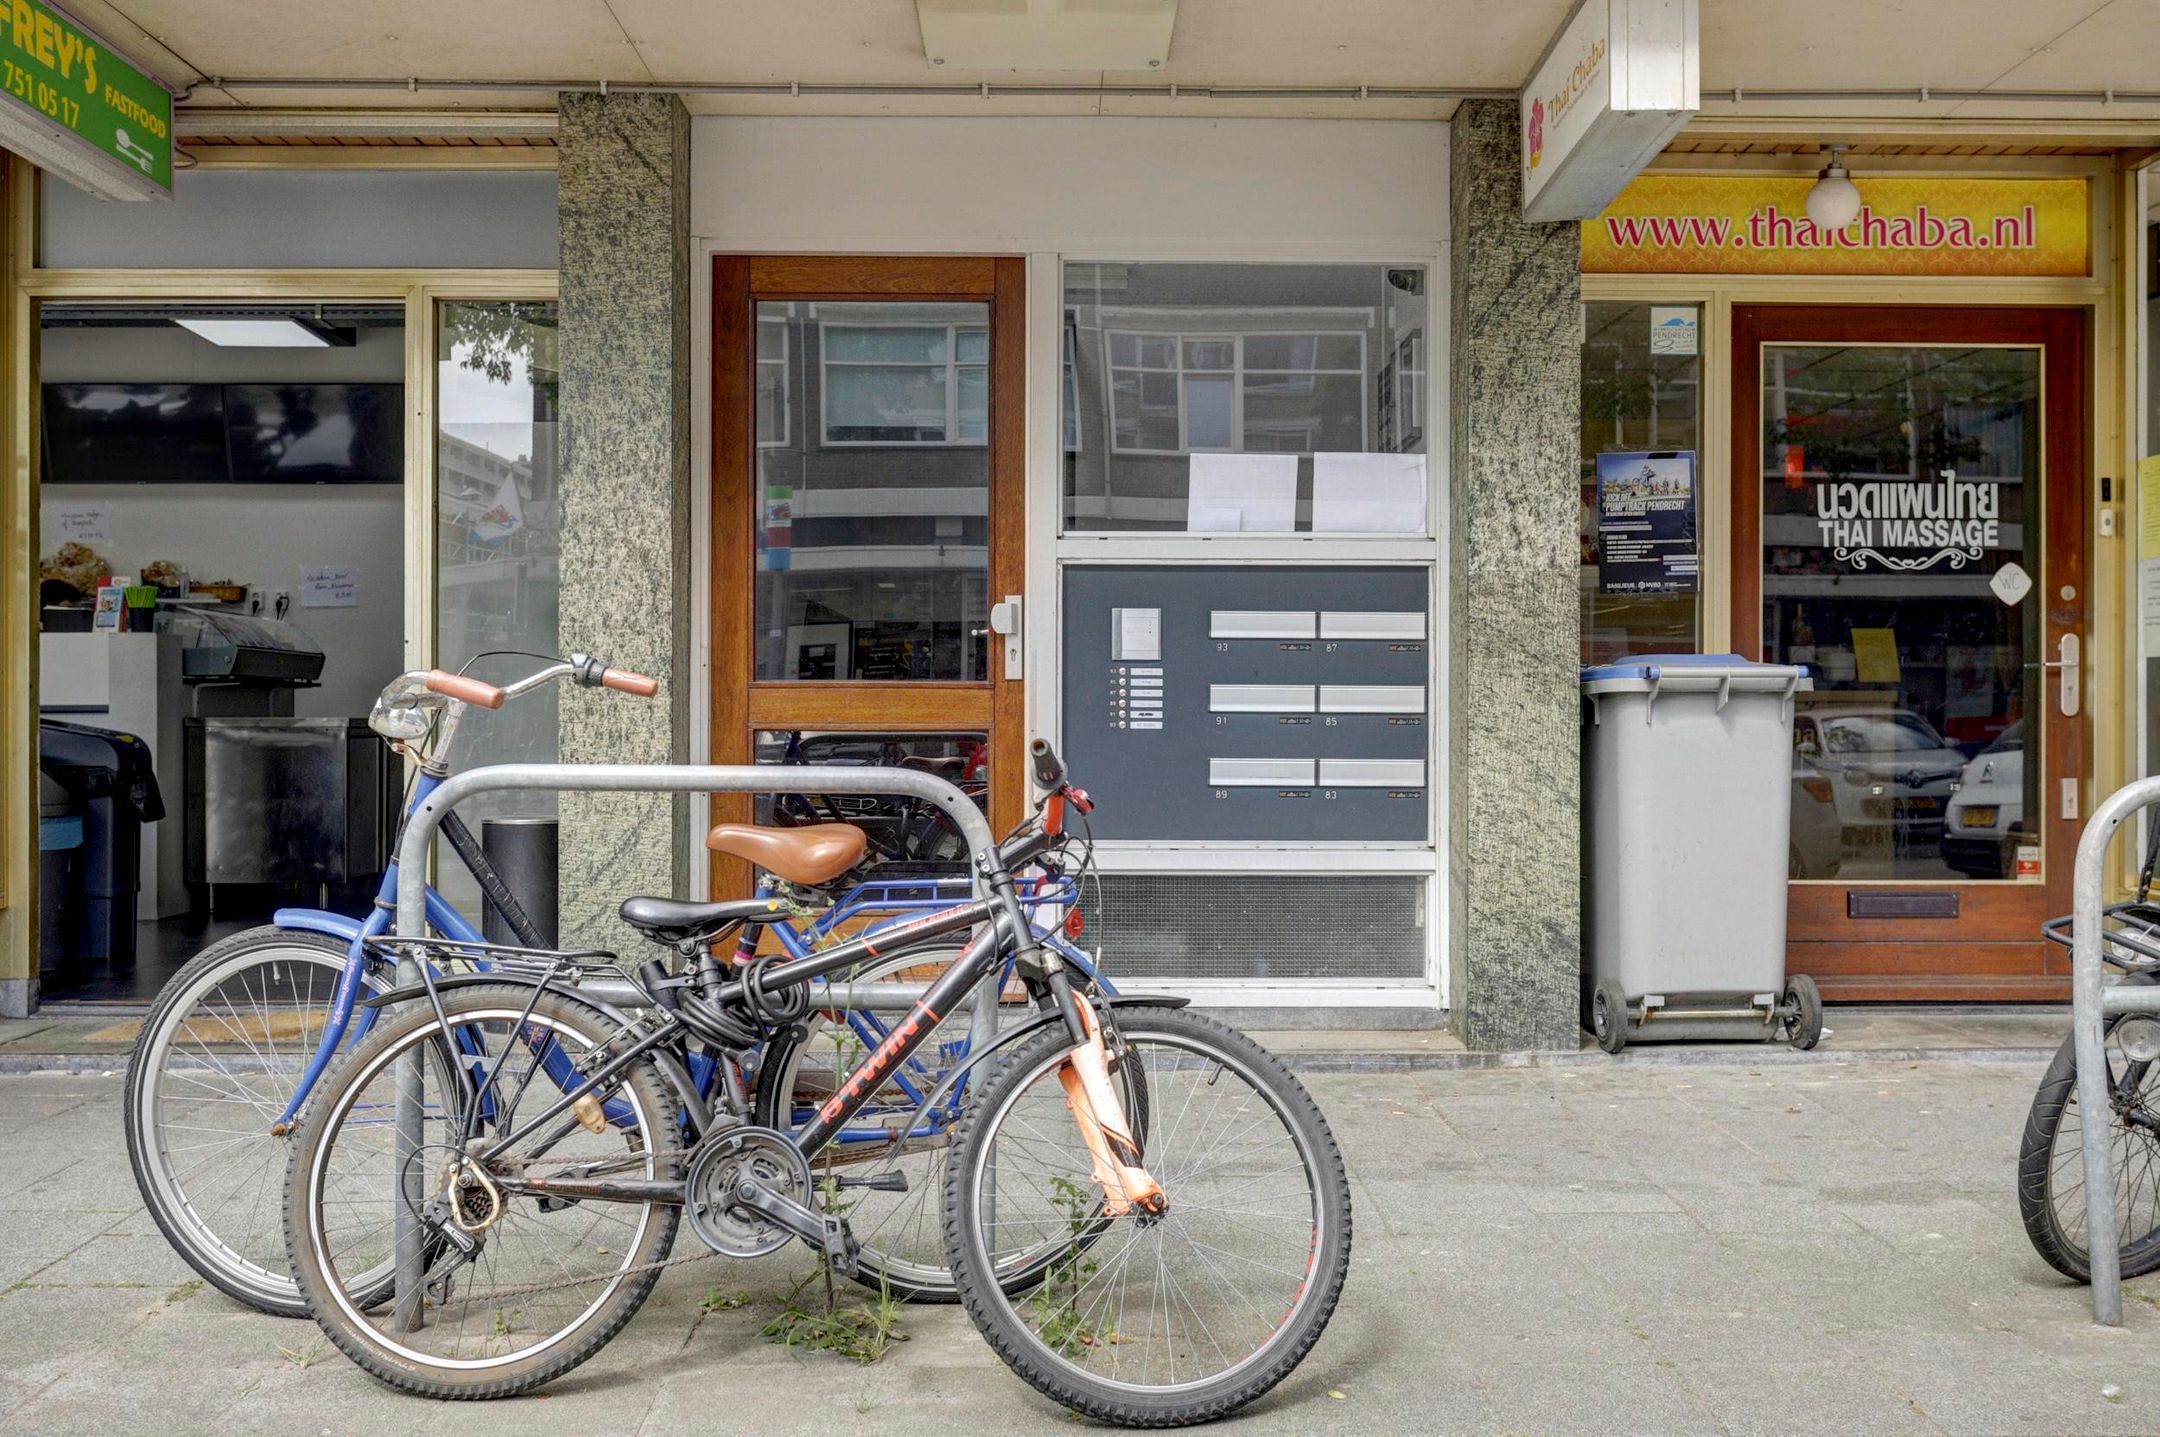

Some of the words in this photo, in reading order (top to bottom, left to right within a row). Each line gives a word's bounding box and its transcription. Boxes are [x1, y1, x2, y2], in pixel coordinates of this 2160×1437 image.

[1547, 75, 1571, 122] Thai
[1572, 38, 1605, 92] Chaba
[4, 60, 33, 103] 751
[38, 82, 58, 117] 05
[62, 96, 81, 128] 17
[104, 84, 166, 139] FASTFOOD
[1606, 501, 1646, 512] PUMPTRACK
[1647, 500, 1685, 511] PENDRECHT
[1818, 520, 1873, 547] THAI
[1882, 519, 1999, 547] MASSAGE
[1997, 572, 2021, 590] WC
[1216, 642, 1228, 652] 93
[1326, 643, 1338, 653] 87
[1215, 717, 1228, 726] 91
[1325, 717, 1337, 726] 85
[1215, 790, 1228, 799] 89
[1325, 790, 1337, 800] 83
